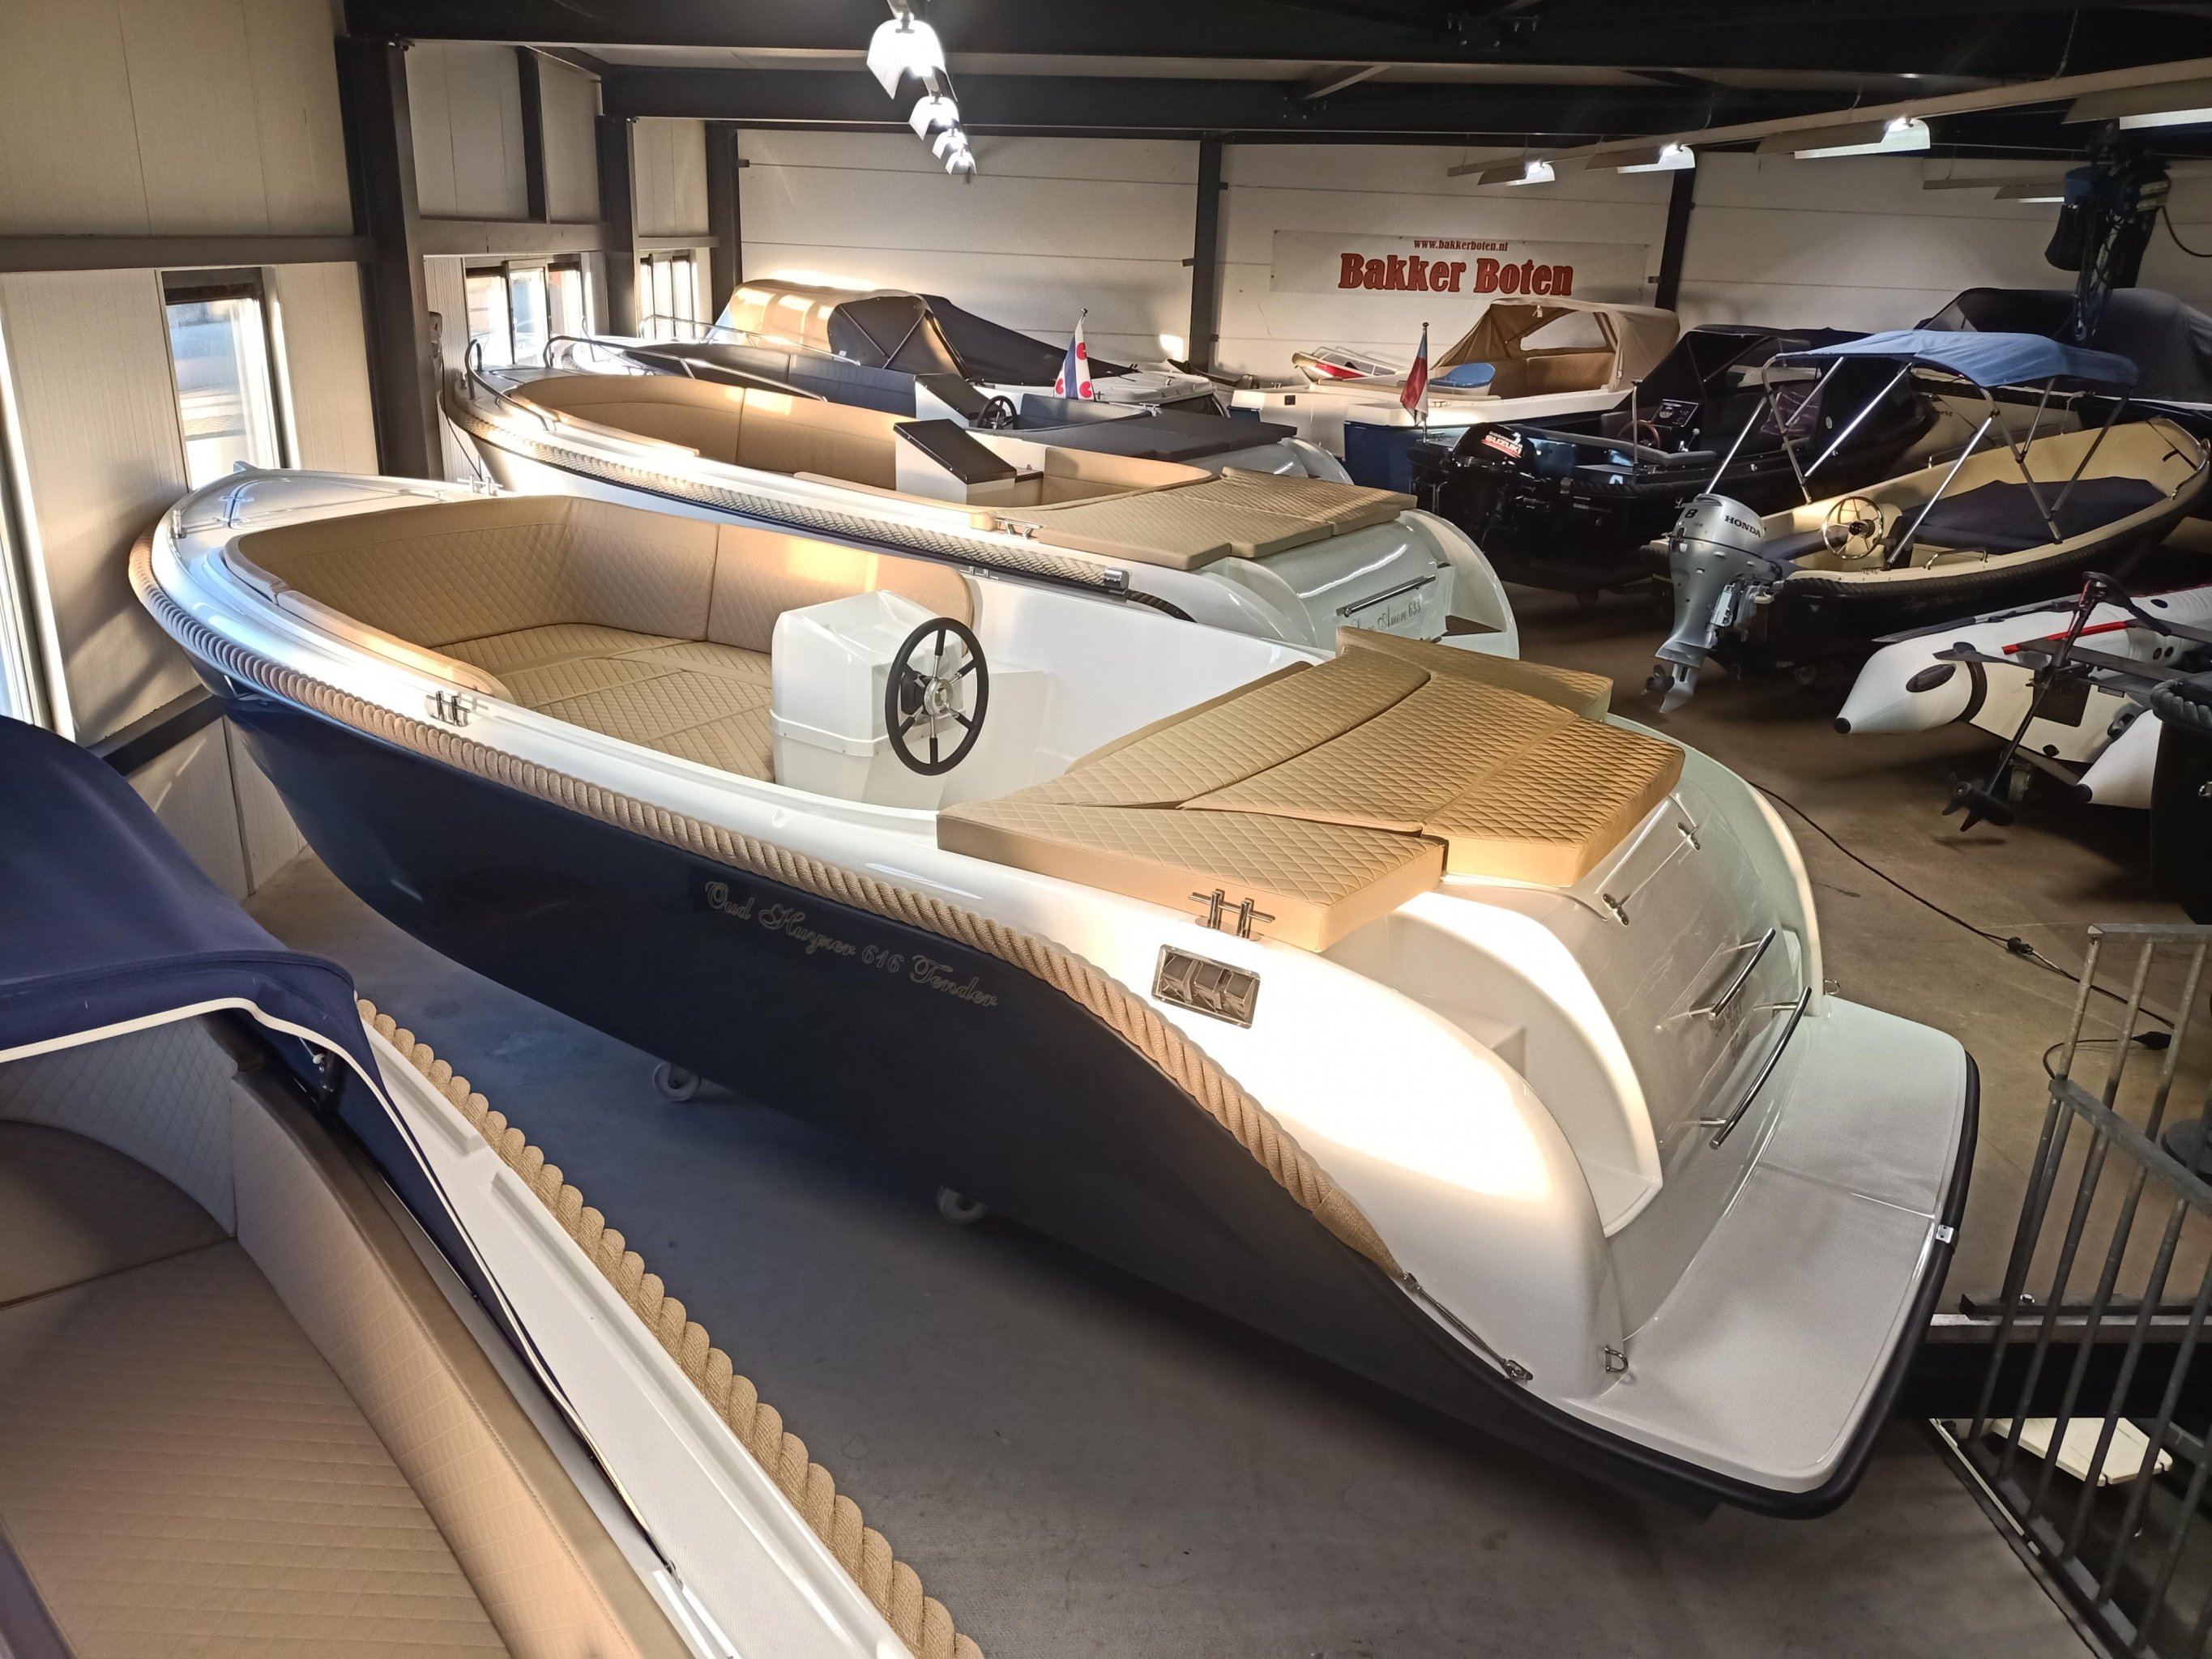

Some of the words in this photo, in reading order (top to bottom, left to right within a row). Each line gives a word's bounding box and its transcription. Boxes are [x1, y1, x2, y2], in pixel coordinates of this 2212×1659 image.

[1413, 239, 1509, 252] www.bakkerboten.nl
[1338, 252, 1467, 293] Bakker
[1473, 258, 1574, 296] Boten
[1484, 434, 1522, 455] SUZUKI
[1685, 508, 1698, 519] 8
[1723, 514, 1762, 538] HONDA
[1377, 603, 1407, 631] Amore
[1408, 598, 1421, 618] 633
[704, 880, 753, 921] Oud
[861, 944, 906, 975] 616
[909, 953, 998, 1008] Tender
